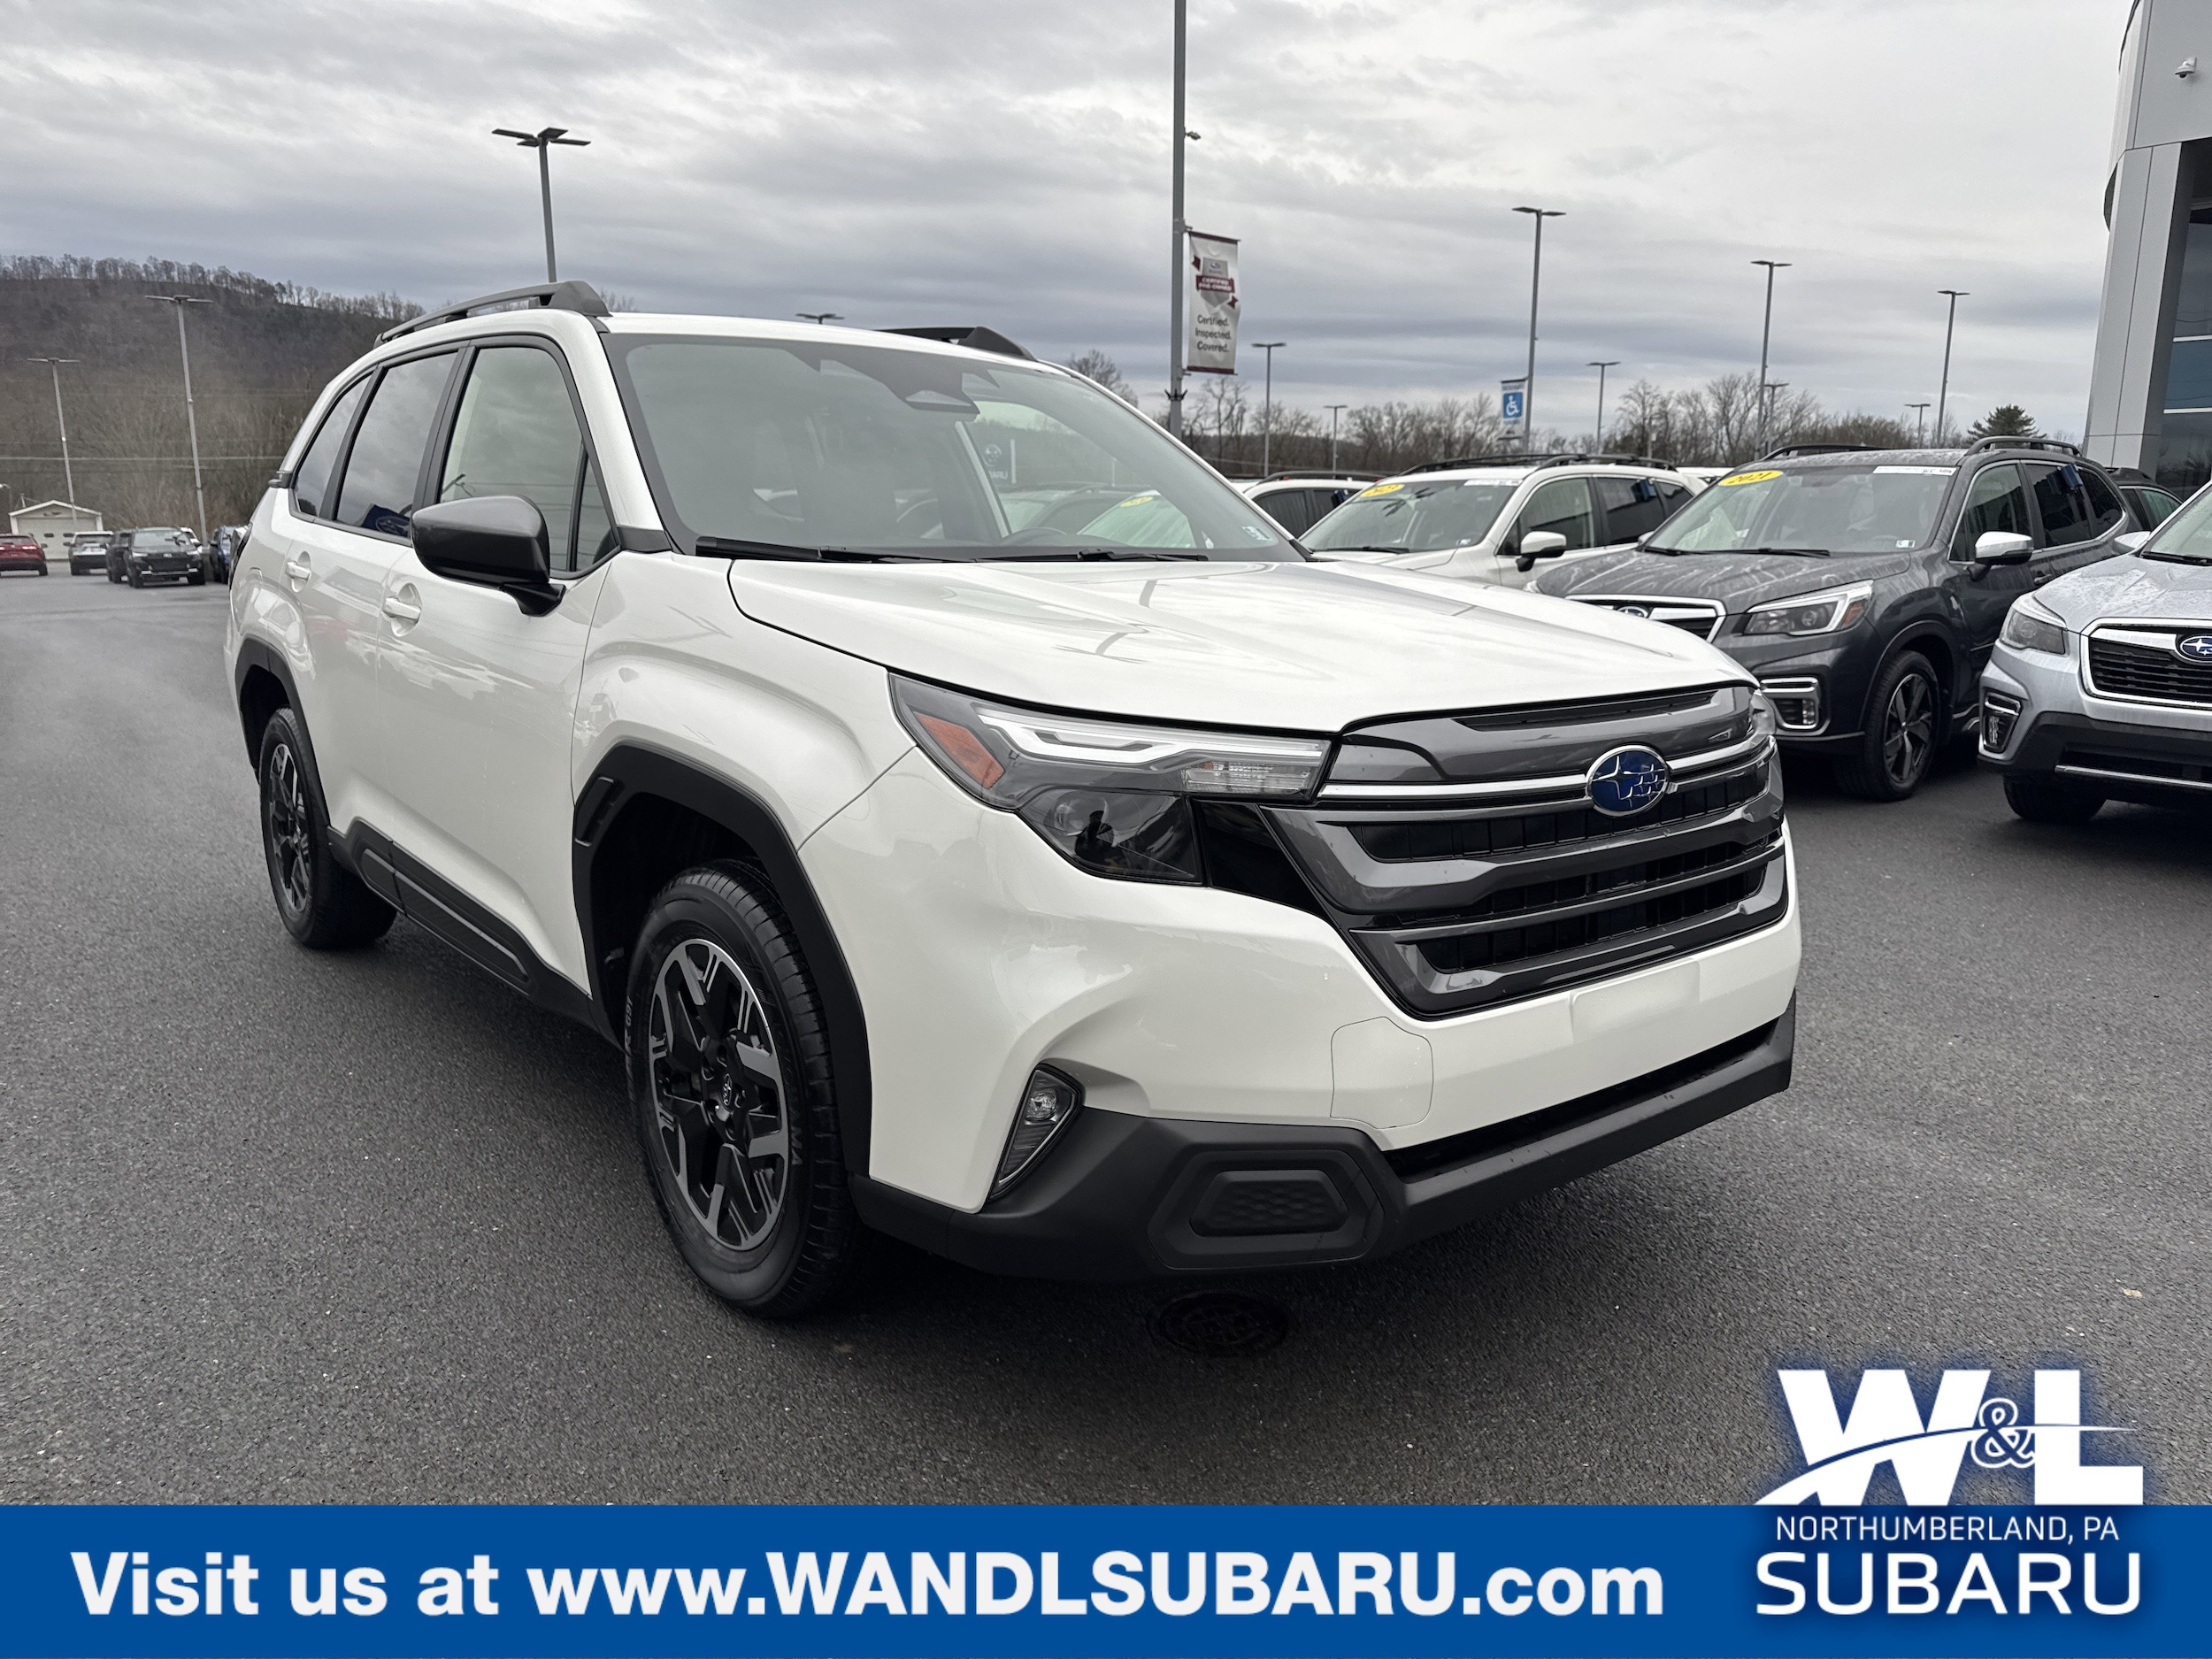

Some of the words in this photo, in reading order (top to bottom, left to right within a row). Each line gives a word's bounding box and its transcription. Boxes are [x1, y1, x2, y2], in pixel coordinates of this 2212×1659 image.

[1196, 314, 1228, 327] Certified.
[1194, 326, 1232, 341] Inspected.
[1196, 341, 1229, 353] Covered.
